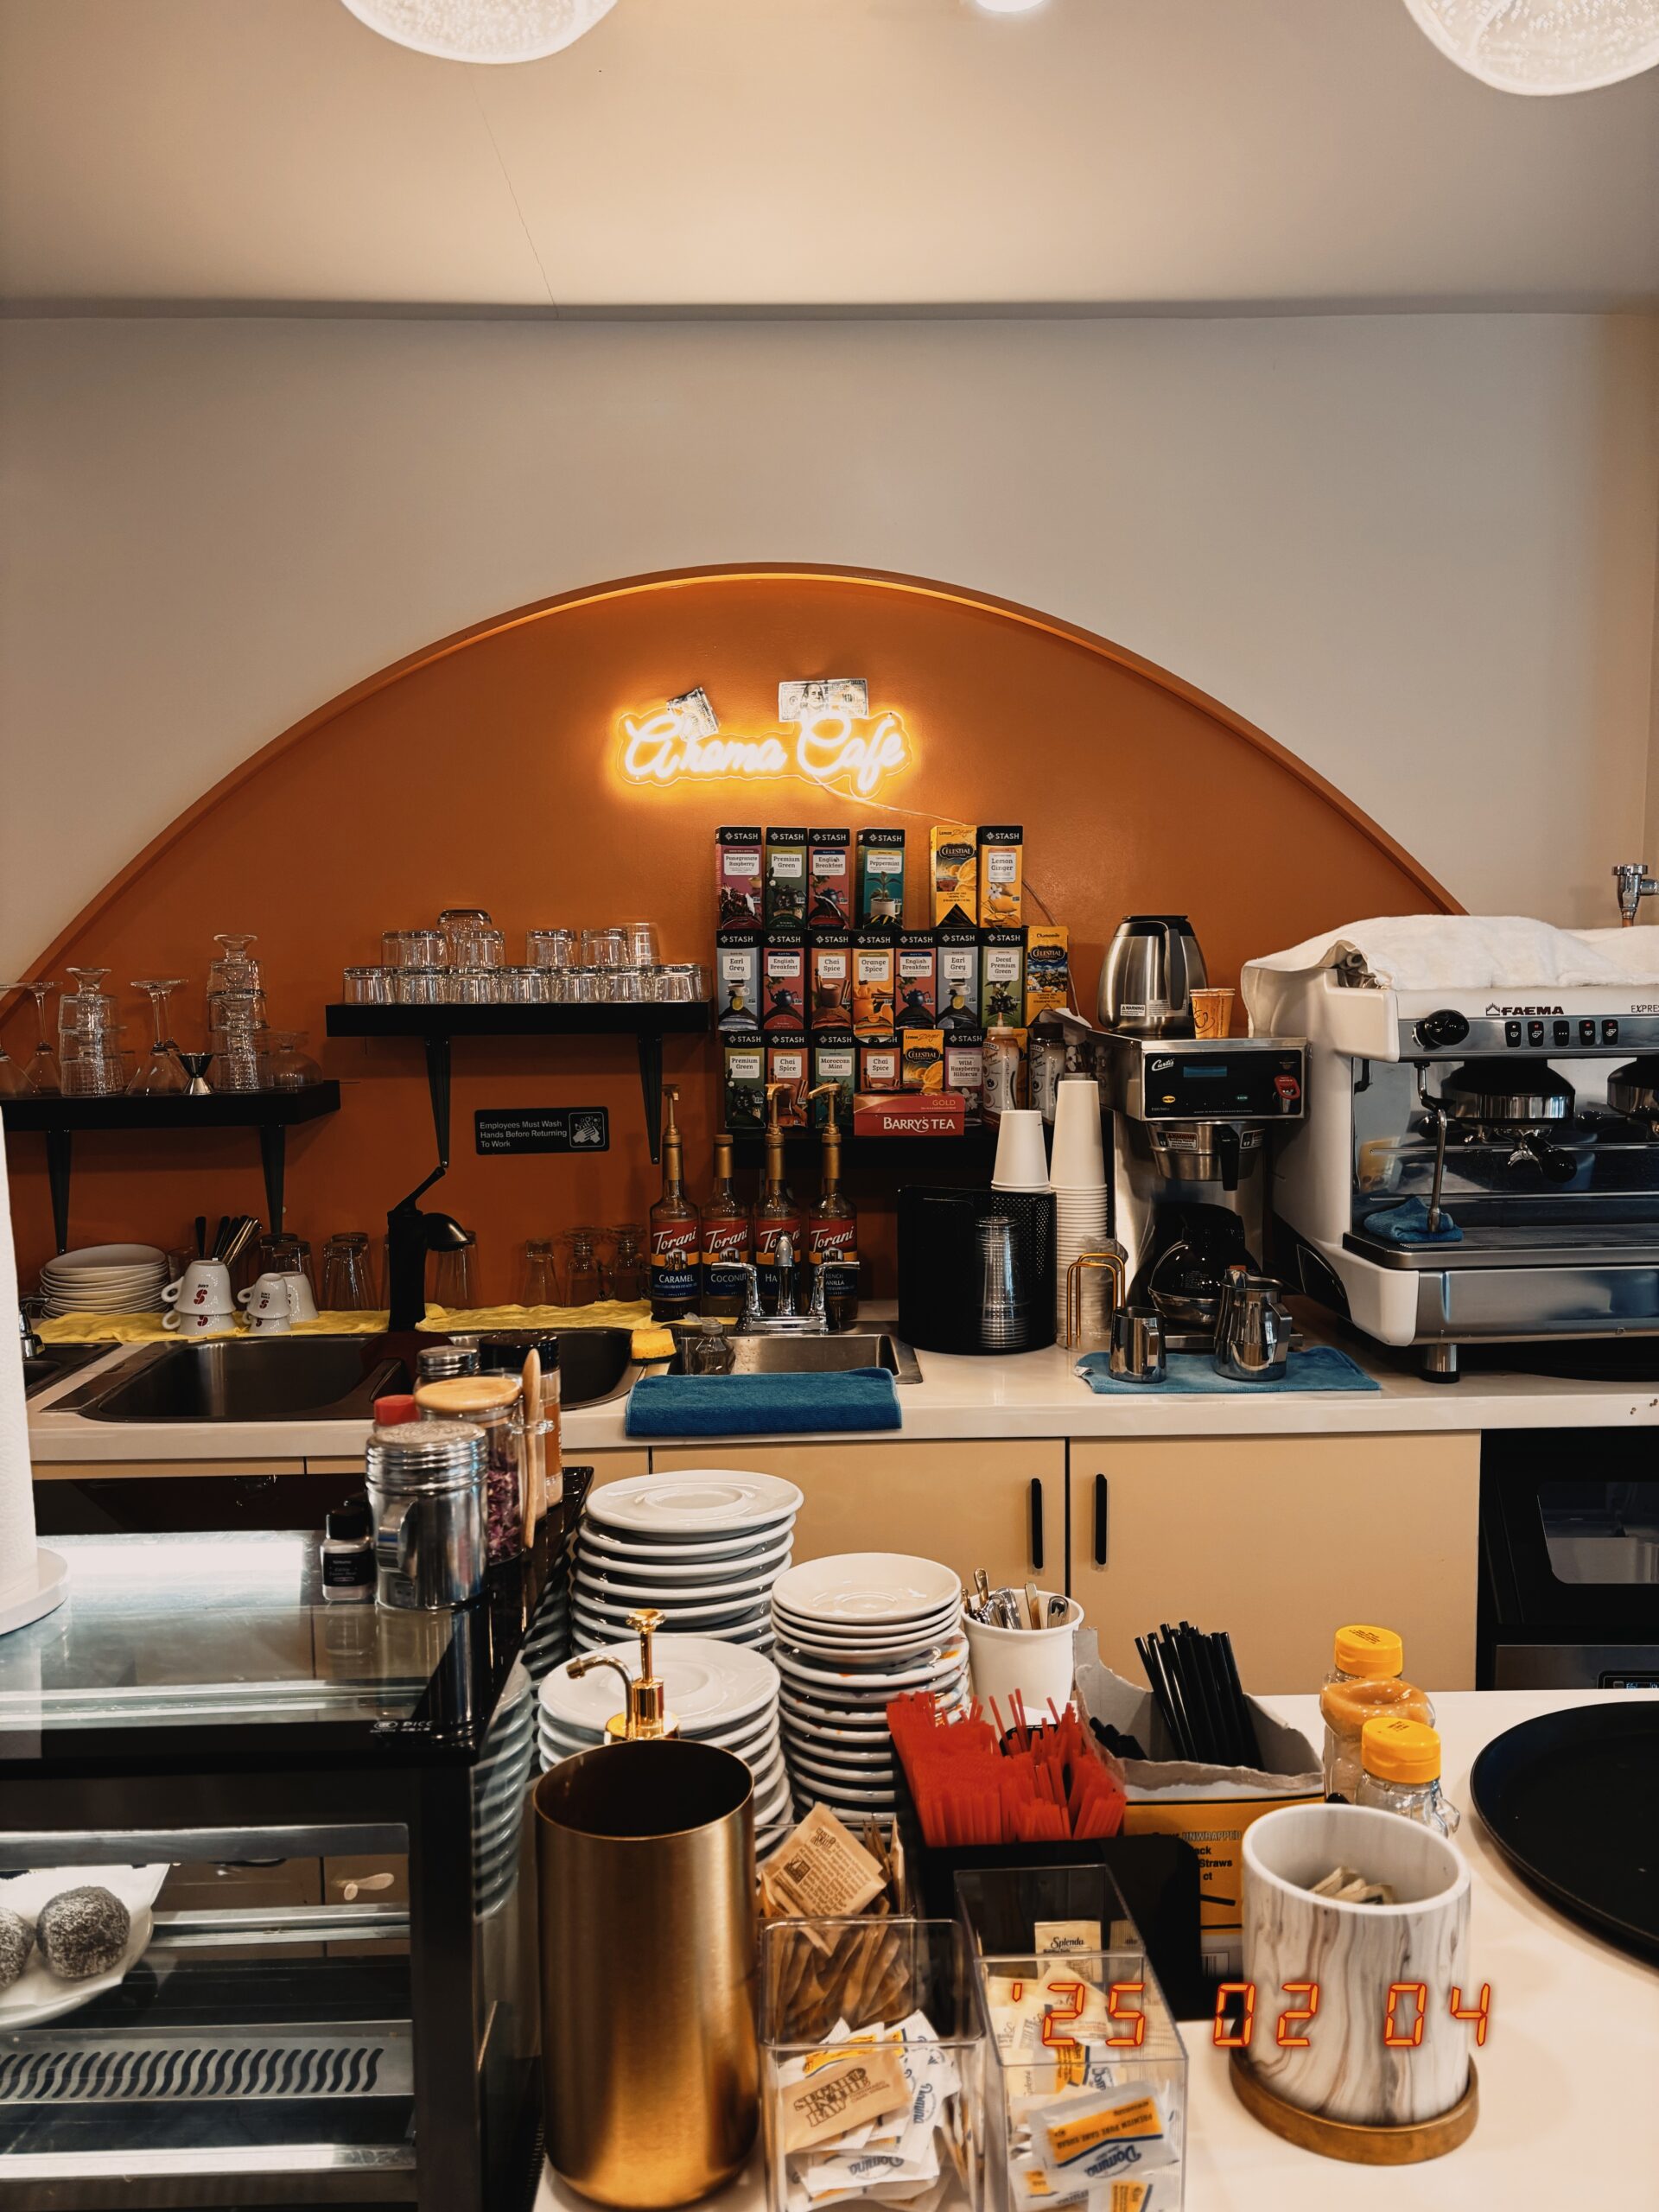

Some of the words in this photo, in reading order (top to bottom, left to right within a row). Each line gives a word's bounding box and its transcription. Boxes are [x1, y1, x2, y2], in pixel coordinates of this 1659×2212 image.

[625, 714, 787, 779] Aroma
[796, 710, 906, 792] Cafe
[942, 847, 972, 855] CELESTIAL
[1033, 949, 1062, 957] CELESTIAL
[1501, 1006, 1564, 1016] FAEMA
[1630, 1004, 1659, 1014] EXPRE
[907, 1049, 938, 1058] CELESTIAL
[1151, 1058, 1174, 1071] Curtis
[480, 1122, 520, 1130] Employees
[542, 1120, 563, 1128] Wash
[883, 1116, 929, 1132] BARRY'S
[932, 1118, 956, 1130] TEA
[531, 1129, 568, 1138] Returning
[653, 1227, 697, 1255] Torani
[705, 1225, 748, 1254] Torani
[810, 1226, 855, 1253] Torani
[658, 1274, 695, 1283] CARAMEL
[710, 1274, 747, 1282] COCONUT
[1183, 1830, 1242, 1841] UNWRAPPED
[1198, 1859, 1233, 1867] Straws
[1051, 1936, 1084, 1949] Splenda
[1121, 2113, 1153, 2129] PREMIUM
[847, 2155, 905, 2176] Domino
[1084, 2145, 1141, 2177] Domino
